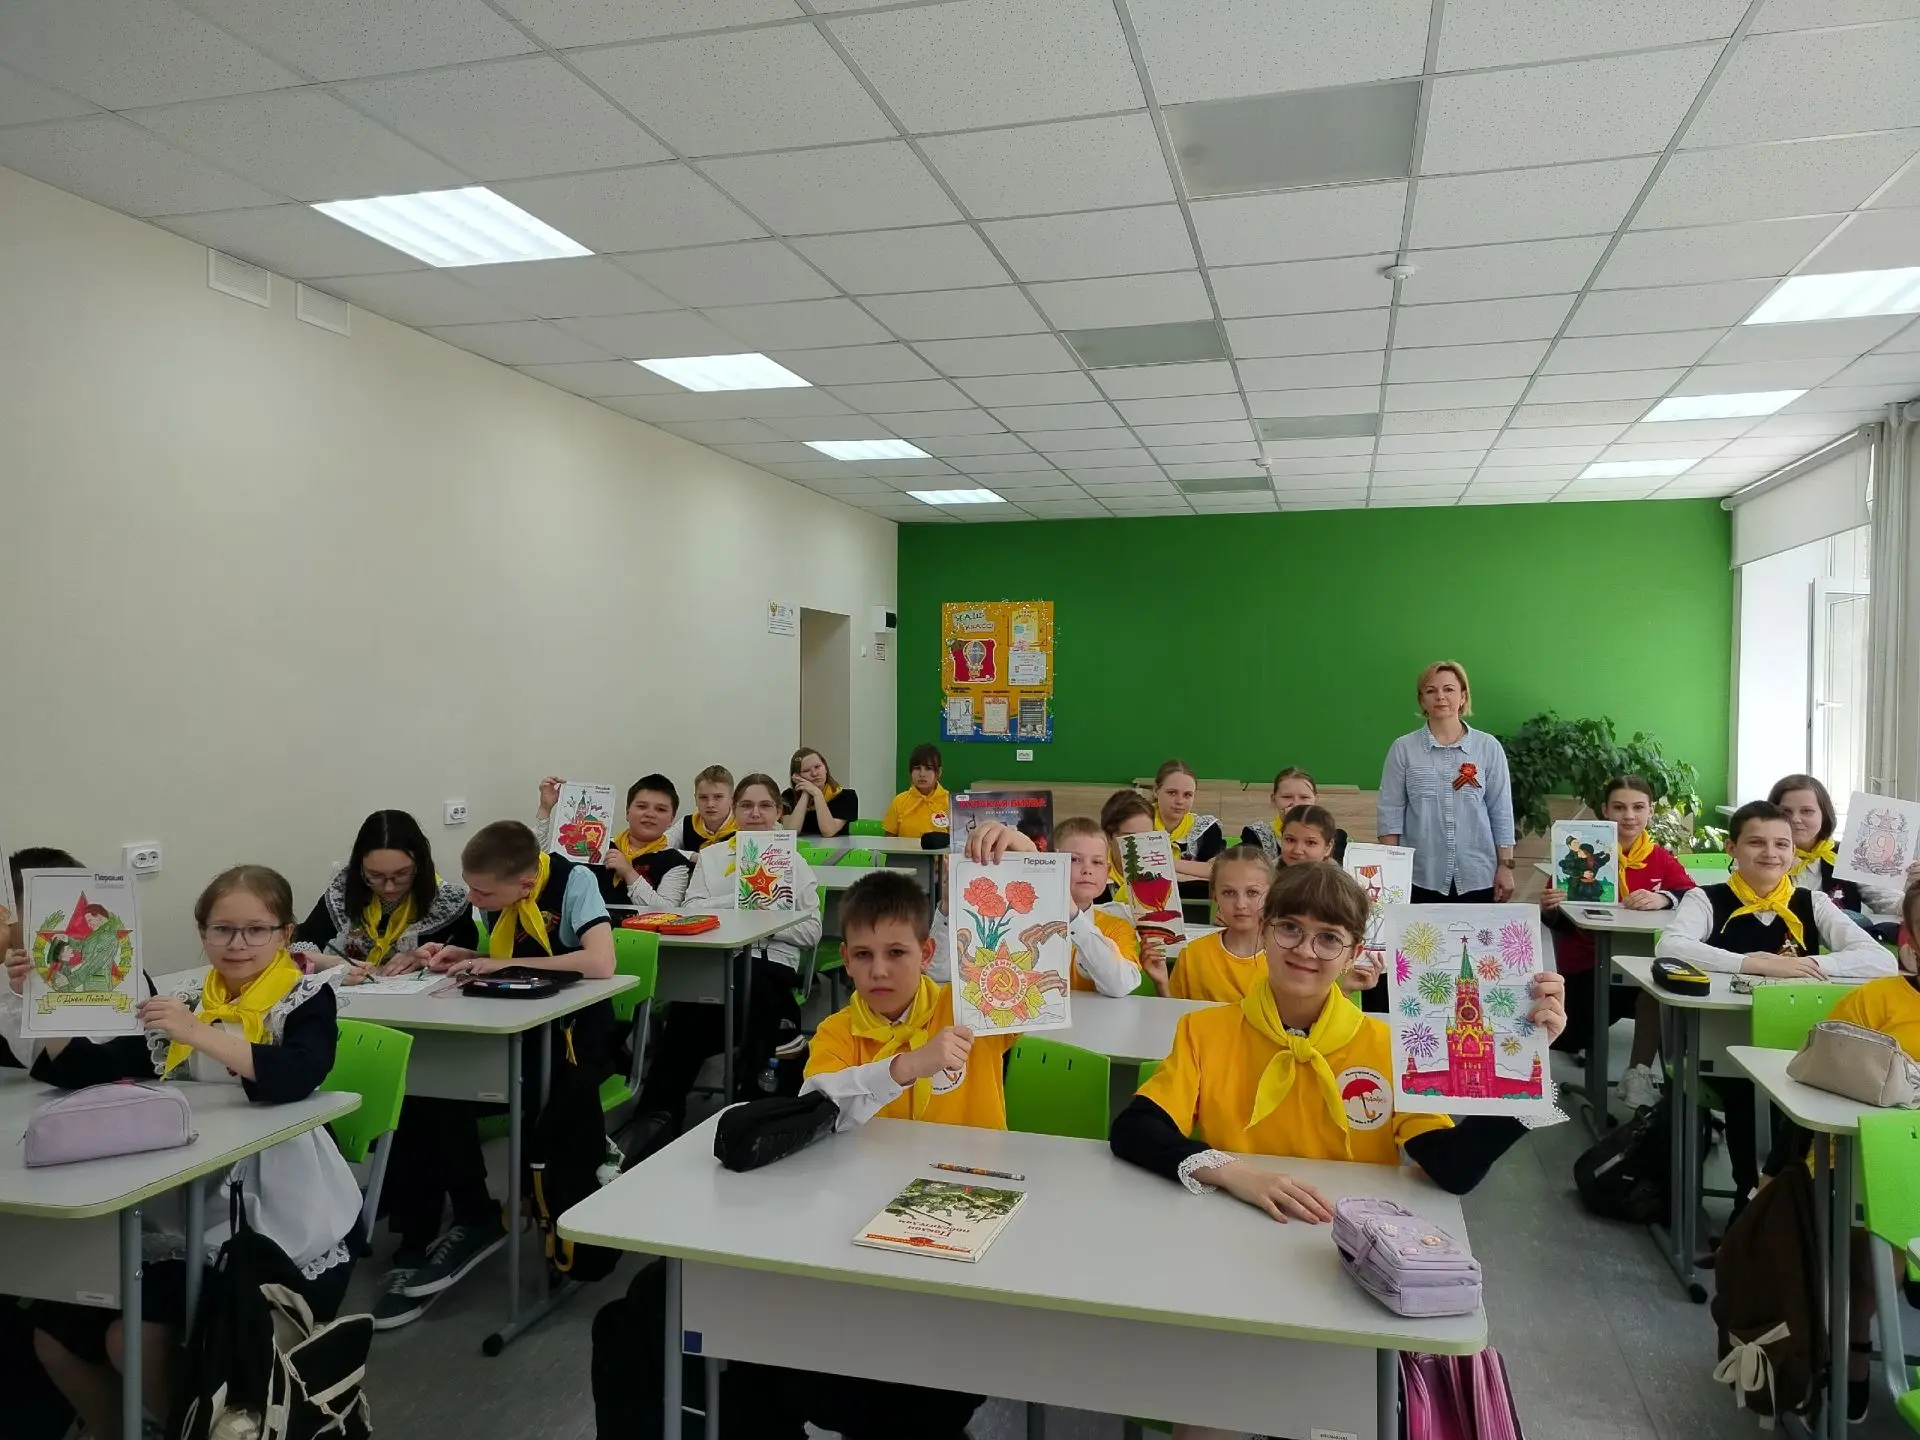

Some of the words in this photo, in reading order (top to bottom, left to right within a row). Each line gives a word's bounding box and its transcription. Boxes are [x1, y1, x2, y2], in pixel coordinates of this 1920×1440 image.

[1868, 830, 1895, 862] 9
[1023, 857, 1057, 866] Первые
[94, 873, 124, 883] Первые
[980, 960, 1022, 1003] ОТЕЧЕСТВЕННАЯ
[1010, 978, 1027, 1003] ВОЙНА
[907, 1225, 952, 1237] Поклон
